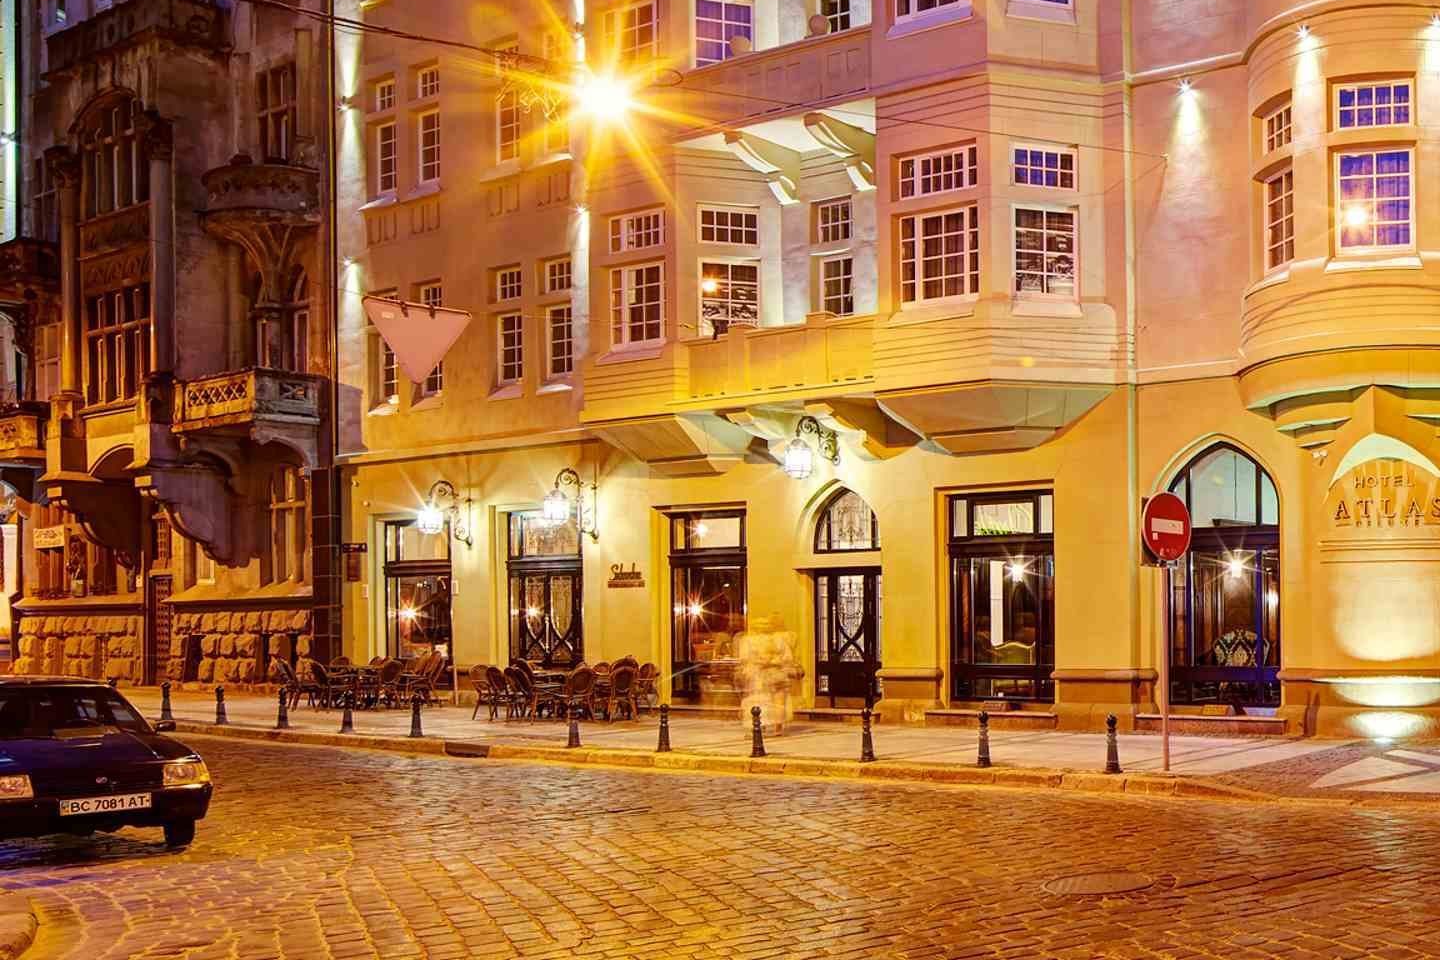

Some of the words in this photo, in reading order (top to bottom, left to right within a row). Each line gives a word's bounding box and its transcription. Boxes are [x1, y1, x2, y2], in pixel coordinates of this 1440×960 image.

[1354, 475, 1415, 488] HOTEL
[70, 801, 90, 813] BC
[94, 798, 125, 811] 7081
[128, 795, 147, 807] AT
